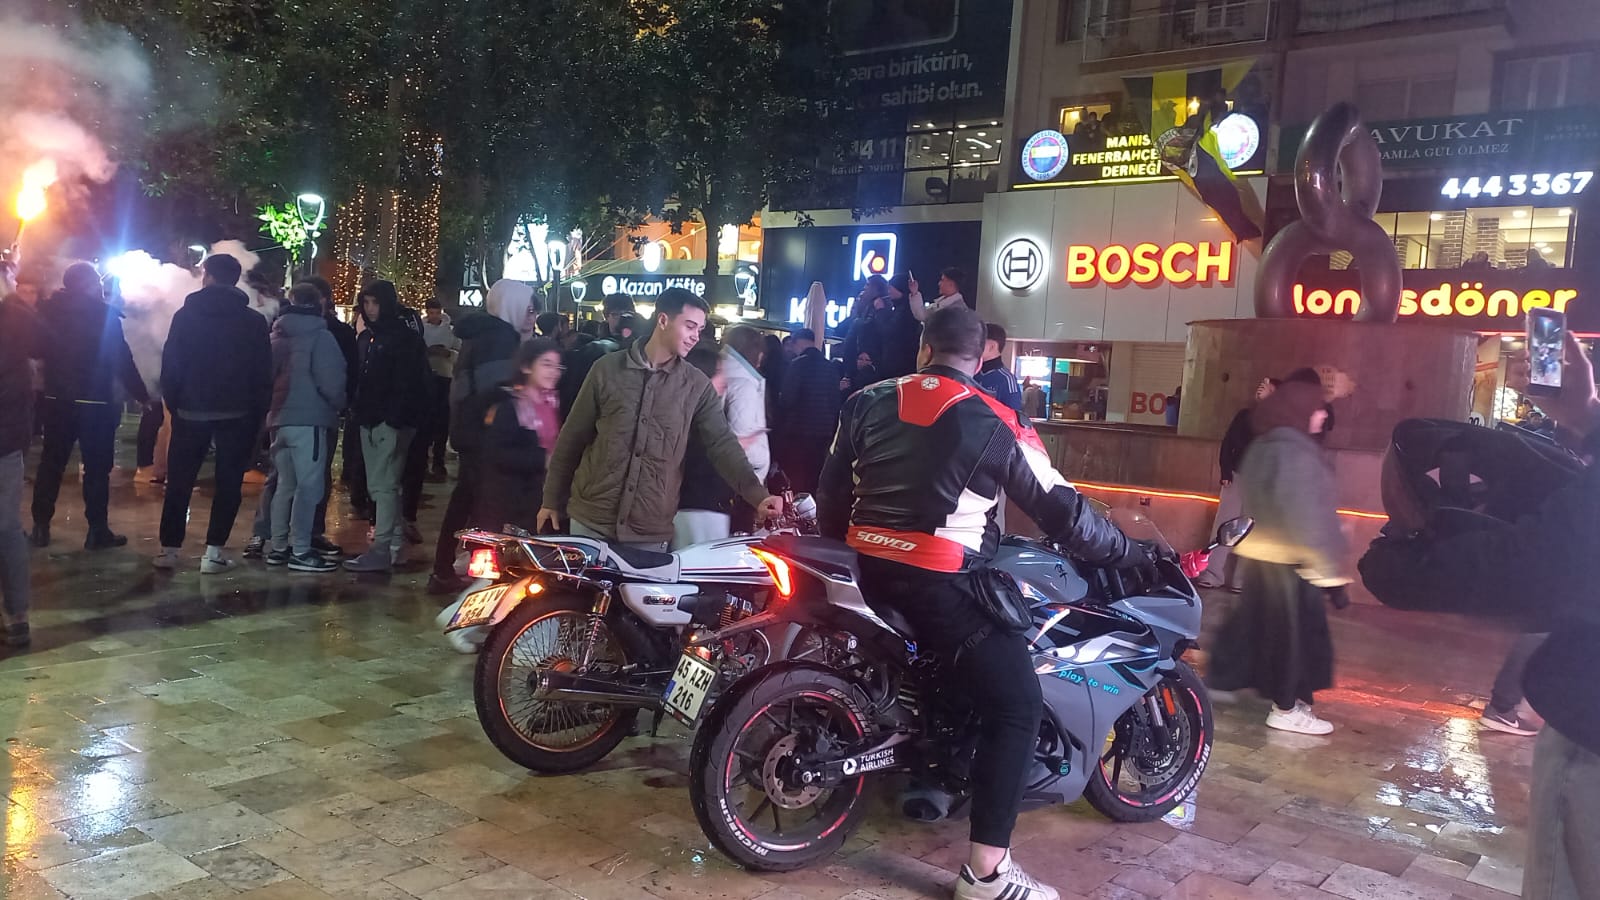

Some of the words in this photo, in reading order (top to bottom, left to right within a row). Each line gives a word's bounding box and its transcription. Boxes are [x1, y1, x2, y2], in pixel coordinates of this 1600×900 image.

[888, 49, 974, 78] biriktirin,
[881, 82, 935, 107] sahibi
[937, 80, 983, 101] olun.
[1106, 134, 1152, 149] MANIS
[1370, 118, 1524, 145] AVUKAT
[1072, 148, 1160, 165] FENERBAHÇE
[1067, 241, 1233, 284] BOSCH
[619, 278, 663, 296] Kazan
[1292, 282, 1578, 317] lonsdöner
[1131, 391, 1168, 416] BO
[855, 530, 918, 551] SCOYCO
[677, 658, 693, 679] 45
[689, 666, 713, 692] AZH
[1058, 669, 1084, 684] play
[1087, 677, 1099, 688] to
[1103, 683, 1120, 695] win
[672, 685, 694, 711] 216
[860, 747, 894, 762] TURKISH
[860, 755, 895, 772] AIRLINES
[1174, 743, 1211, 803] MICHELIN
[719, 798, 769, 857] MICHELIN
